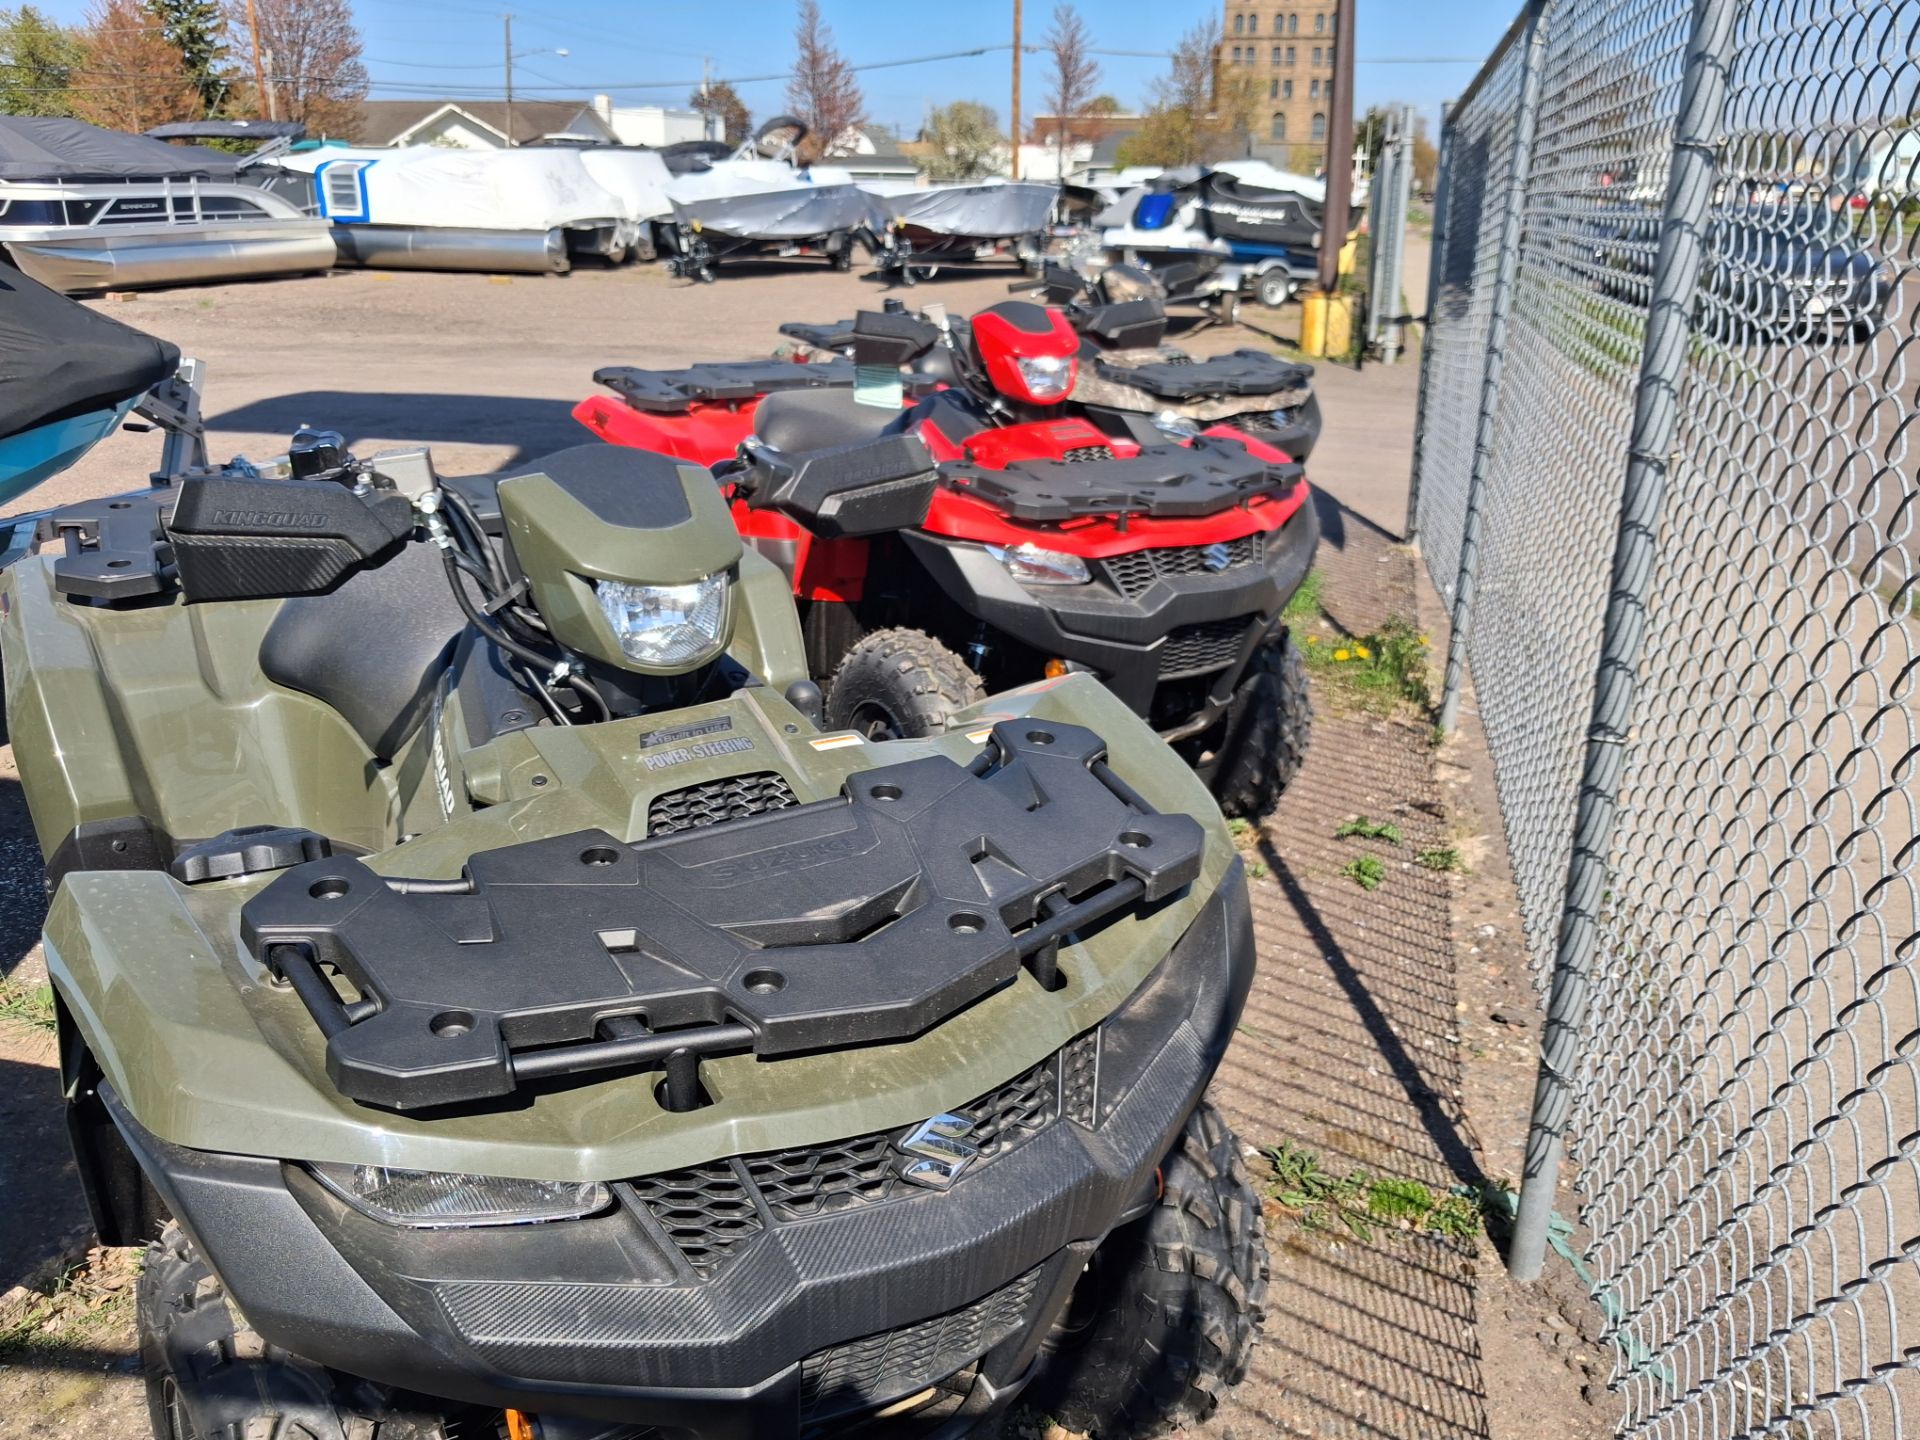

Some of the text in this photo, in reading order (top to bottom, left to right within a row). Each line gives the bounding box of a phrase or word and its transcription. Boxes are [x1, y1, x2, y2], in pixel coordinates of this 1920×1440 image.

[212, 509, 329, 528] KINGQUAD
[662, 722, 731, 744] Built in USA
[643, 736, 755, 771] POWER STEERING
